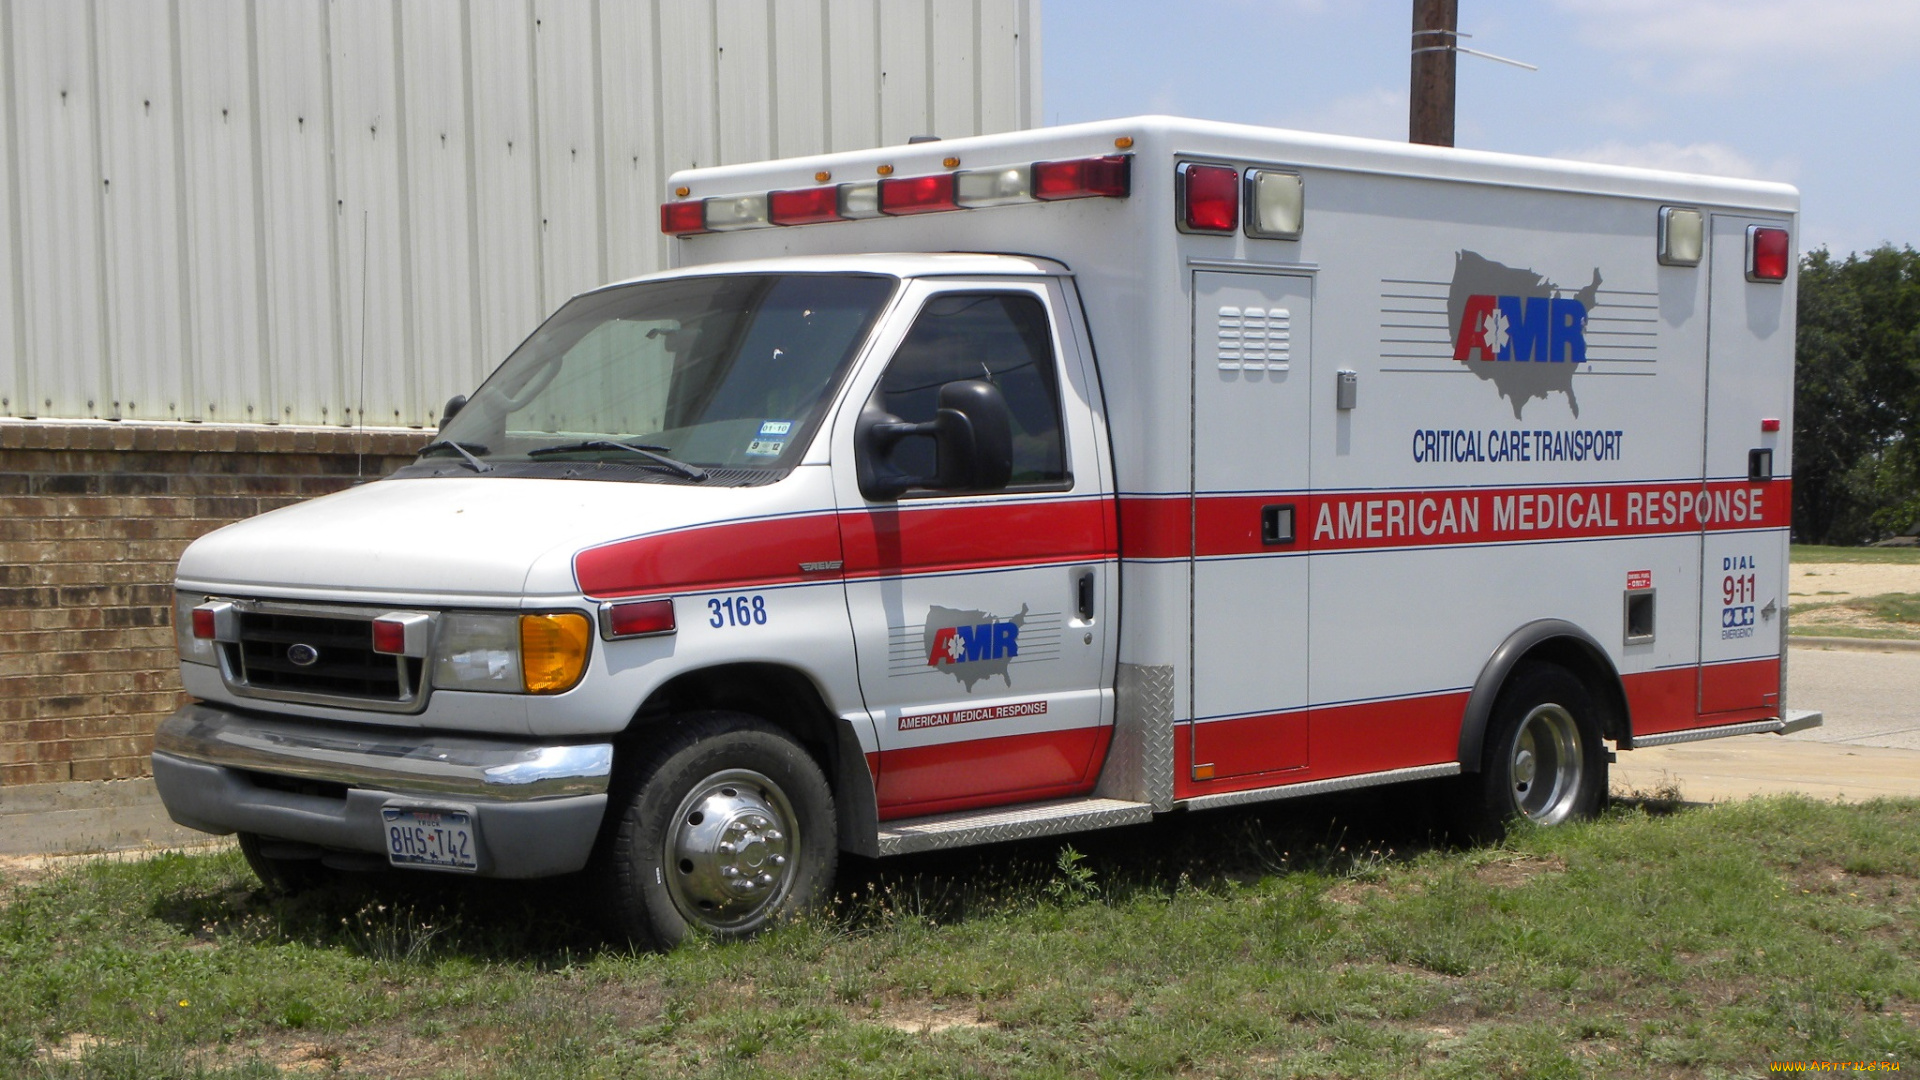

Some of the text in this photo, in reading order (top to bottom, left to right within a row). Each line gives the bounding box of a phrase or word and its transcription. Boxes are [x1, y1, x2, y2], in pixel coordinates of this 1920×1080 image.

[1453, 294, 1588, 363] AMR
[1412, 429, 1623, 463] CRITICAL CARE TRANSPORT
[1313, 488, 1763, 541] AMERICAN MEDICAL RESPONSE
[1723, 555, 1756, 571] DIAL
[707, 595, 768, 629] 3168
[927, 622, 1019, 666] AMR
[1722, 627, 1755, 640] EMERGENCY
[899, 702, 1046, 729] AMERICAN MEDICAL RESPONSE
[390, 826, 471, 859] 8HS T42
